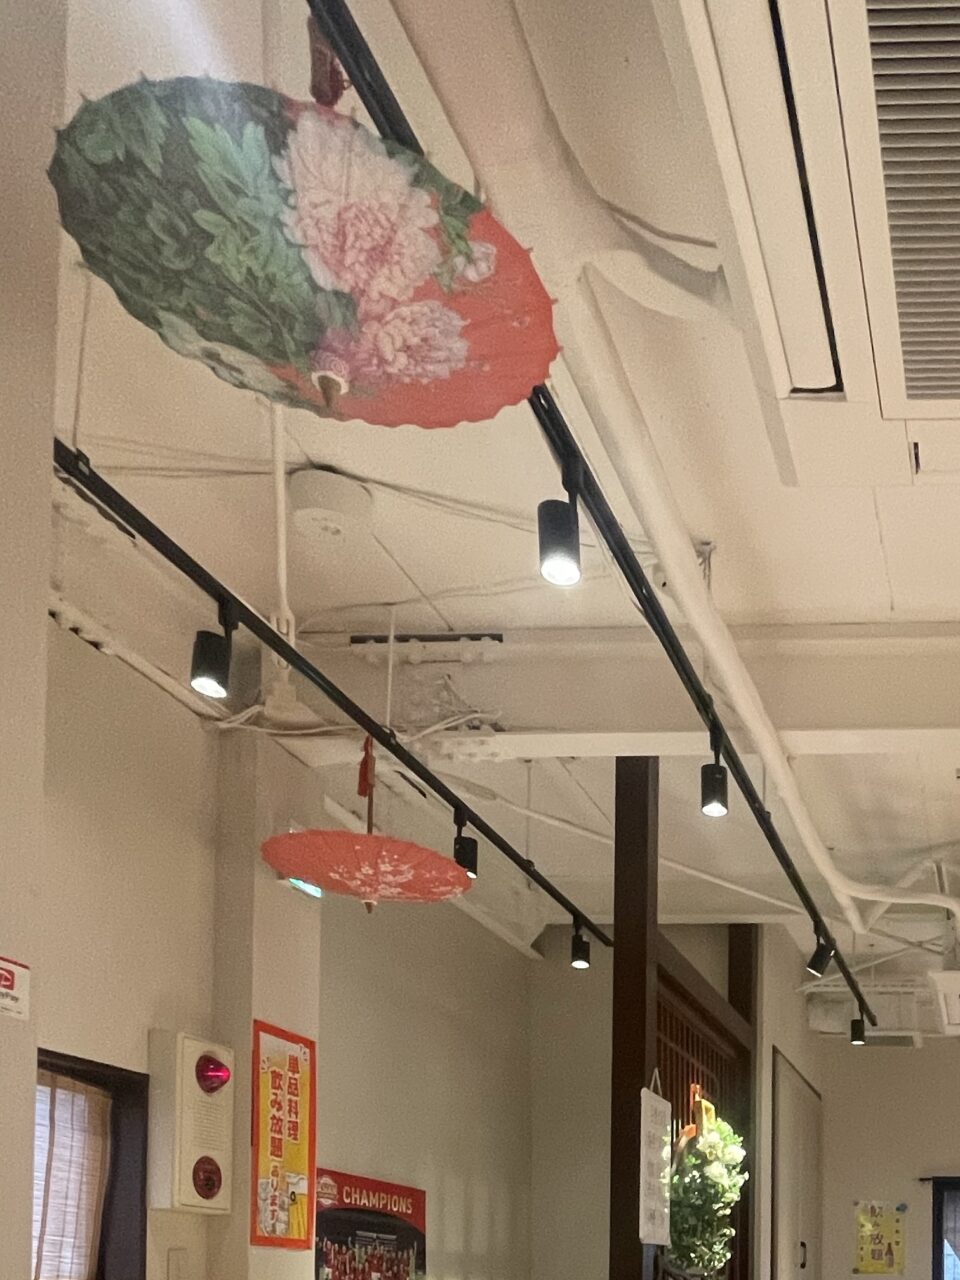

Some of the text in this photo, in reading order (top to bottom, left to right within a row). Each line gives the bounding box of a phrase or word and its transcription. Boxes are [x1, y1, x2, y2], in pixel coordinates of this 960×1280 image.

[287, 1054, 299, 1142] 単品料理
[342, 1186, 413, 1214] CHAMPIONS
